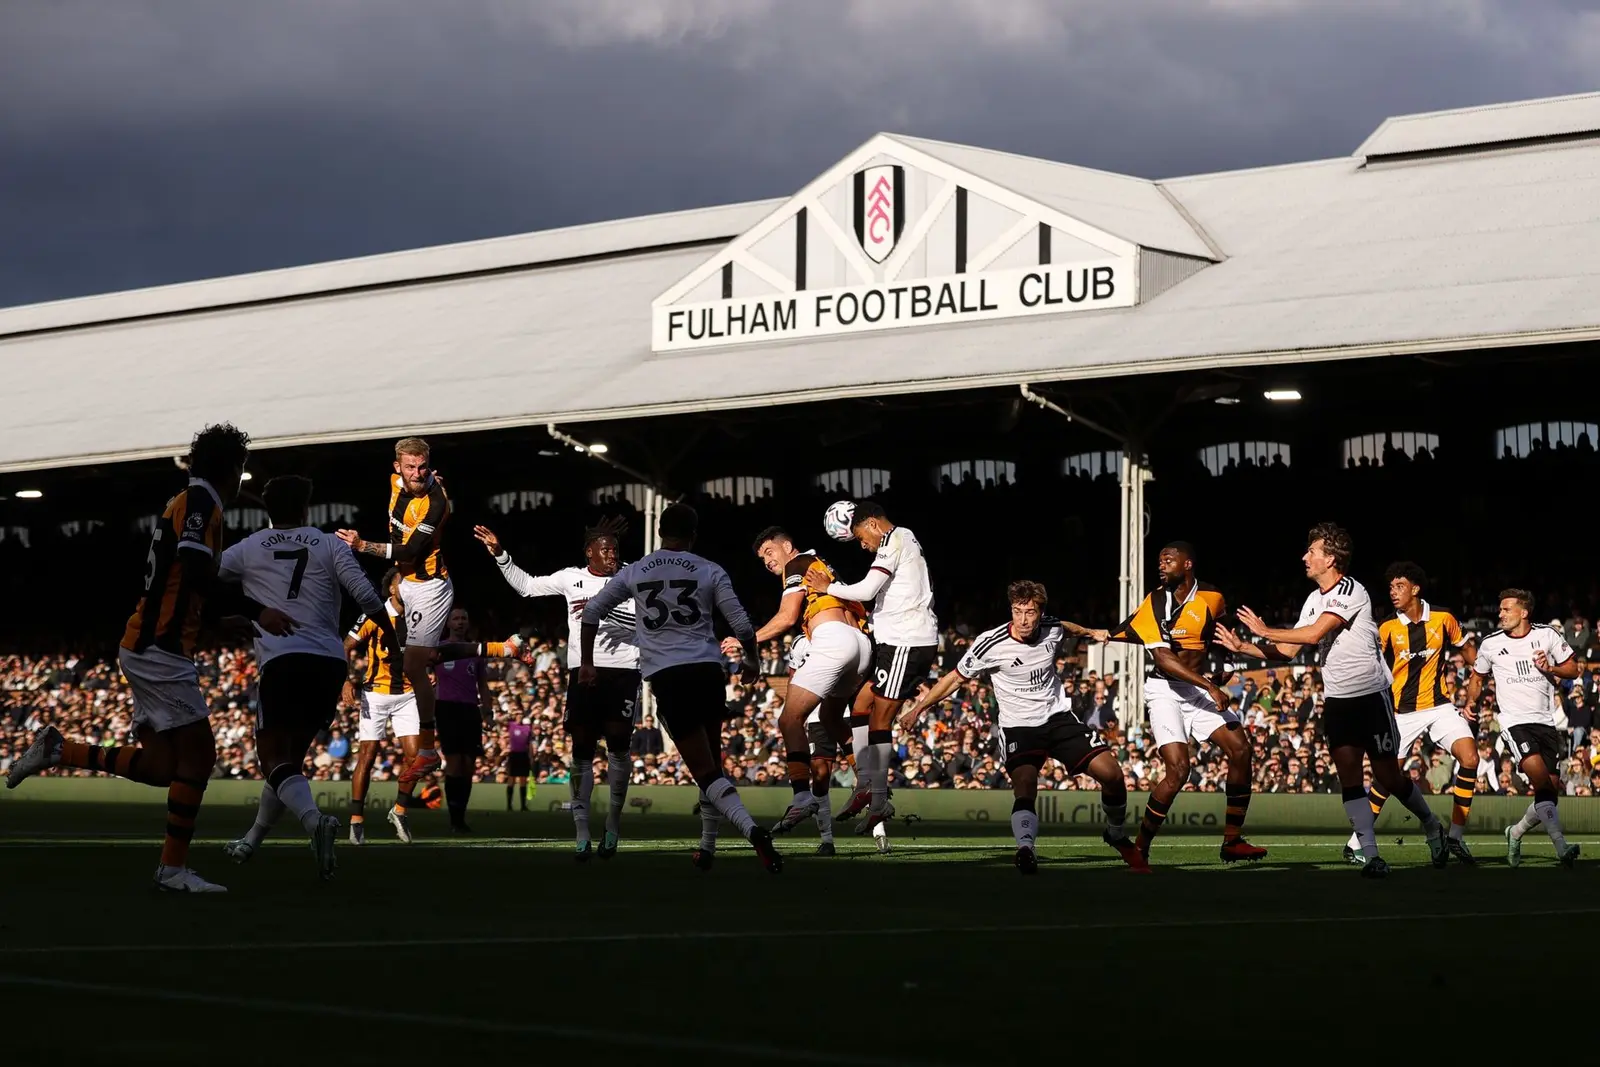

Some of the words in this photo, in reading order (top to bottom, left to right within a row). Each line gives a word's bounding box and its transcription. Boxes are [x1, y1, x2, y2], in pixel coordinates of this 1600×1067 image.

[868, 176, 891, 243] FFC
[669, 299, 796, 341] FULHAM
[816, 279, 998, 327] FOOTBALL
[1019, 266, 1114, 307] CLUB
[274, 547, 309, 600] 7
[641, 558, 698, 574] ROBINSON
[411, 610, 423, 629] 9
[636, 579, 701, 630] 33
[621, 699, 635, 718] 3
[1373, 731, 1393, 754] 16
